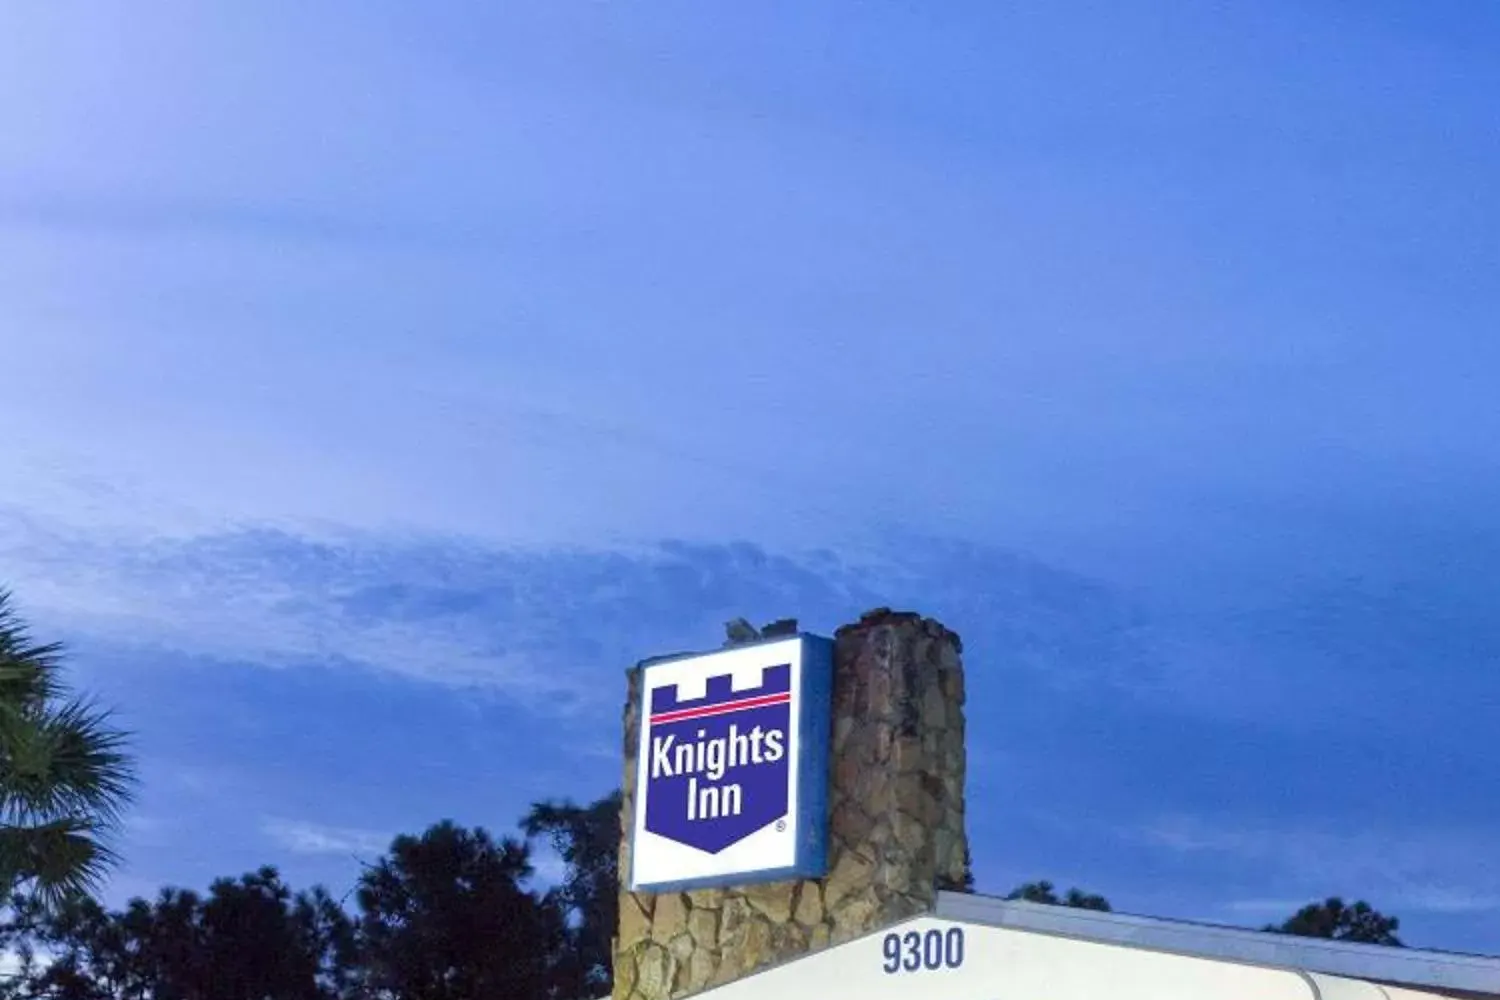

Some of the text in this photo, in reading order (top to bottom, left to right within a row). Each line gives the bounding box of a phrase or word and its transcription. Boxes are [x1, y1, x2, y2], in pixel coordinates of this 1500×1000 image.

[652, 724, 784, 780] Knights
[687, 778, 742, 820] Inn
[883, 927, 964, 974] 9300
